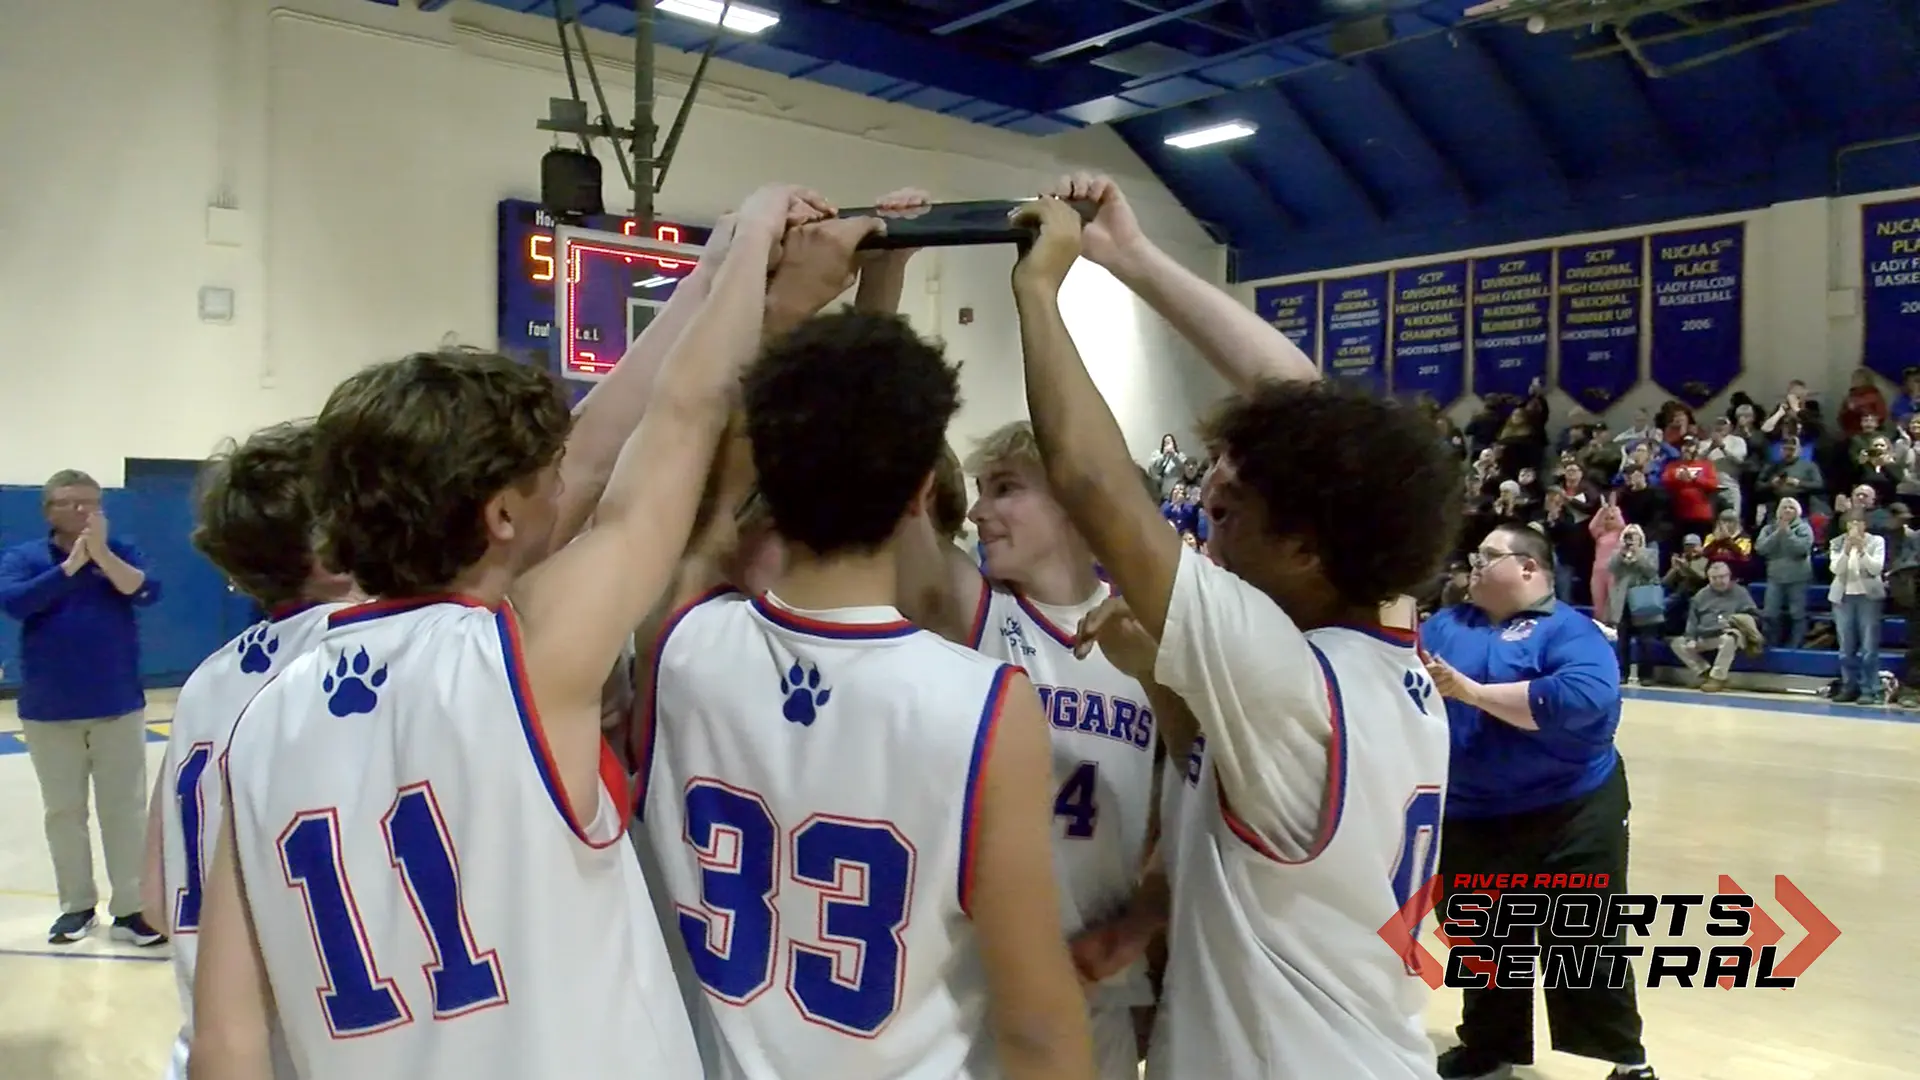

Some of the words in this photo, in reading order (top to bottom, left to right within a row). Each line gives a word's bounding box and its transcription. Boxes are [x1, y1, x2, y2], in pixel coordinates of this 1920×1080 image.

[1661, 243, 1708, 260] NJCAA
[1566, 263, 1633, 279] DIVISIONAL
[1674, 260, 1720, 276] PLACE
[1871, 258, 1910, 273] LADY
[1481, 272, 1542, 290] DIVISIONAL
[1559, 283, 1587, 294] HIGH
[1588, 277, 1642, 291] OVERALL
[1656, 281, 1688, 294] LADY
[1689, 276, 1736, 290] FALCON
[1402, 284, 1458, 299] DIVISIONAL
[1502, 286, 1550, 301] OVERALL
[1659, 291, 1732, 306] BASKETBALL
[1421, 298, 1464, 311] OVERALL
[1571, 294, 1628, 308] NATIONAL
[1483, 303, 1537, 317] NATIONAL
[1615, 308, 1632, 320] UP
[1404, 313, 1454, 326] NATIONAL
[1681, 319, 1711, 331] 2006
[276, 780, 509, 1039] 11
[675, 776, 917, 1039] 33
